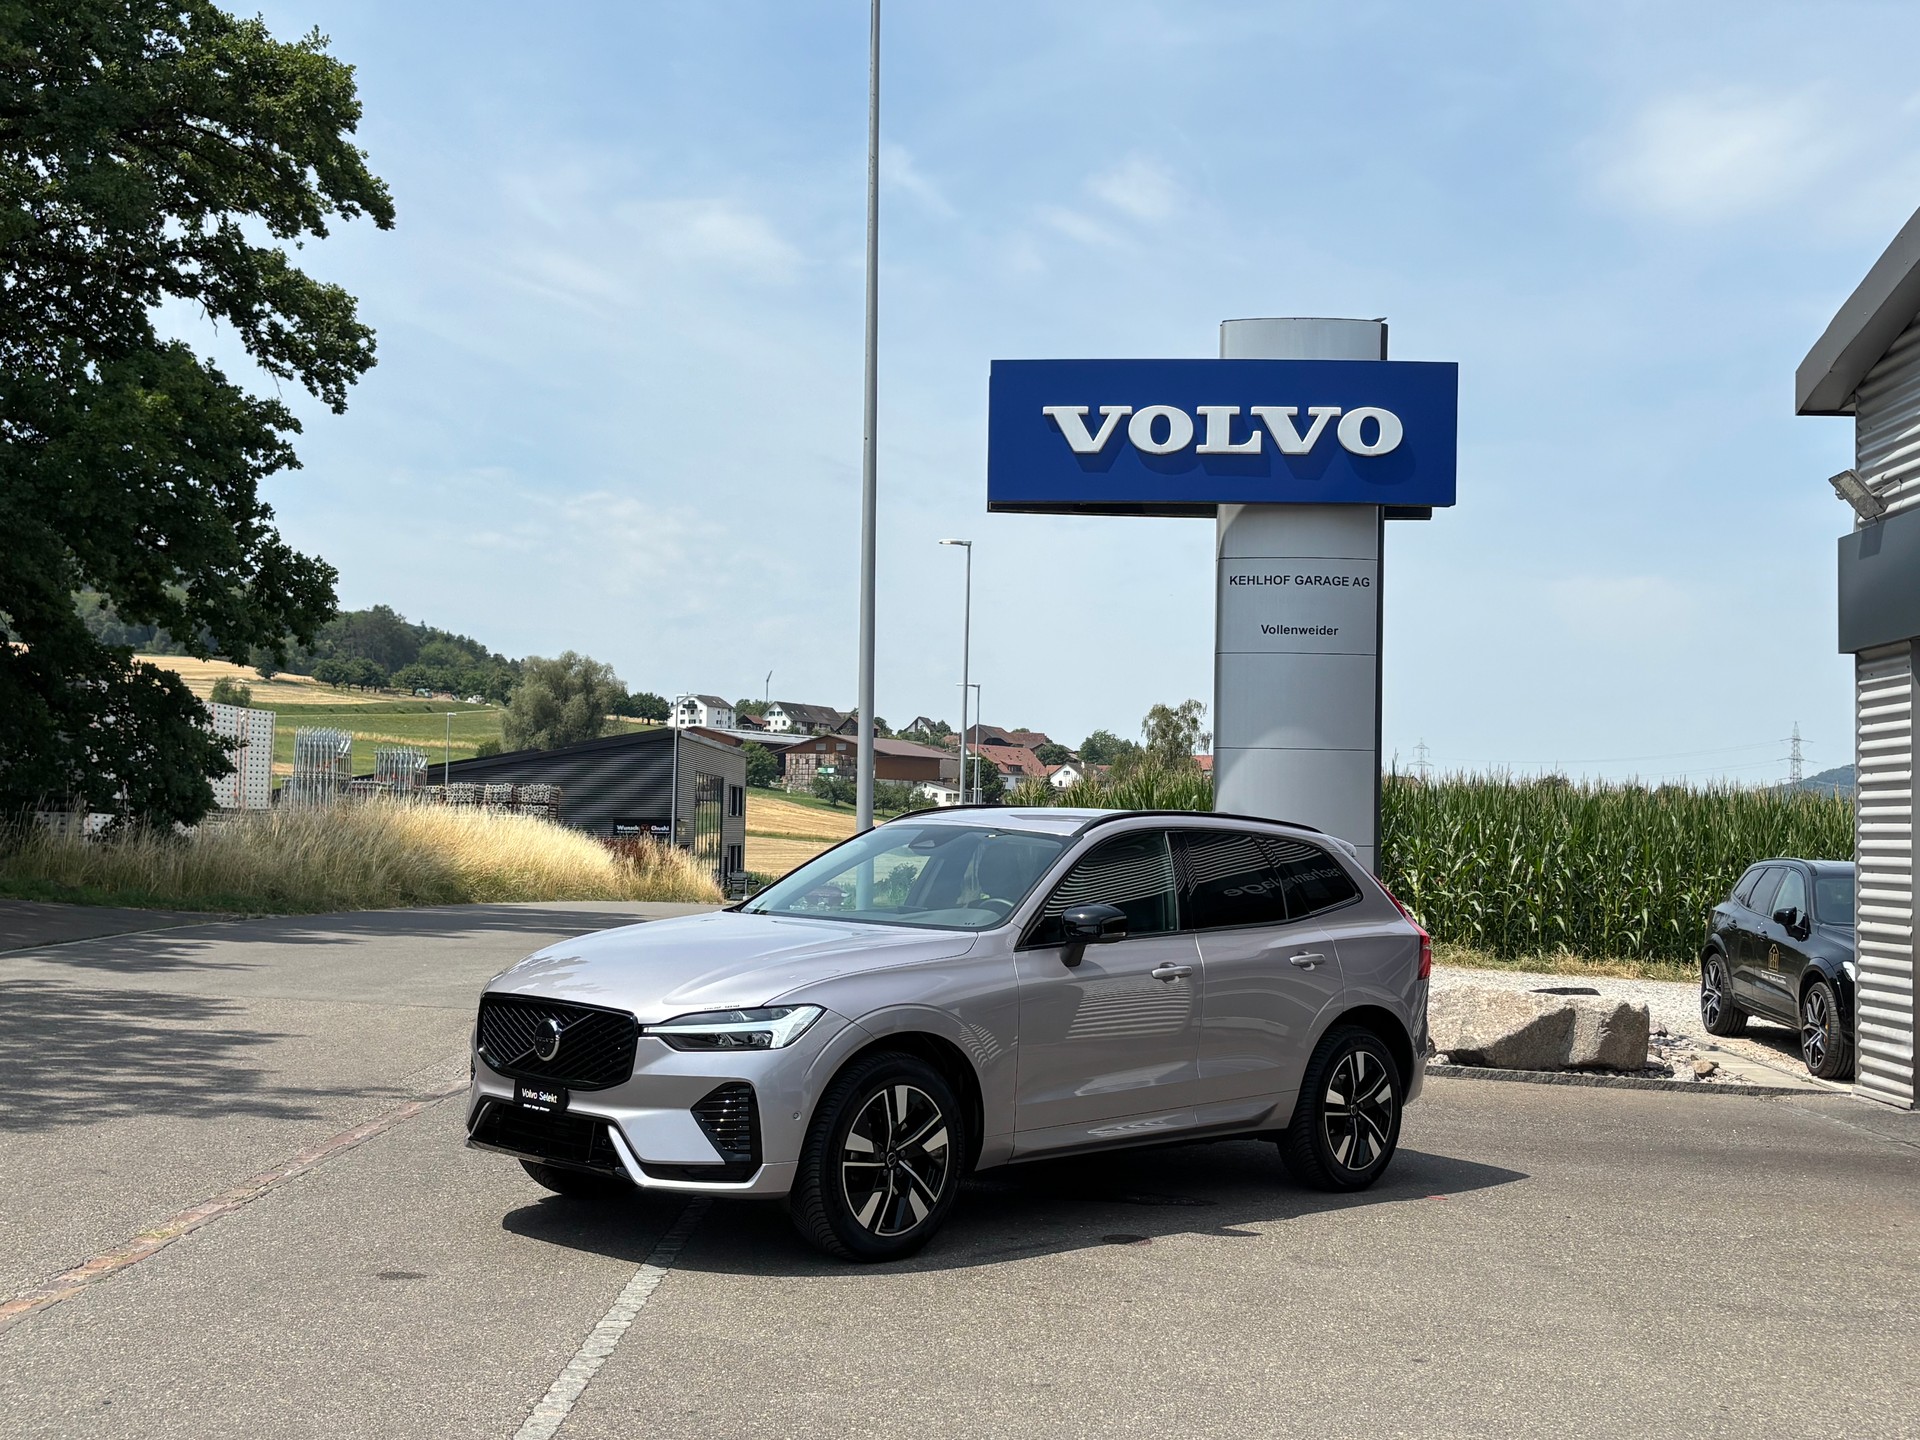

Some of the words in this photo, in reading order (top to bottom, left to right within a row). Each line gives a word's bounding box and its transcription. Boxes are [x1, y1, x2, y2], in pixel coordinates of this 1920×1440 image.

[1042, 405, 1403, 456] VOLVO
[1229, 575, 1291, 586] KEHLHOF
[1294, 575, 1350, 587] GARAGE
[1352, 577, 1371, 588] AG
[1261, 624, 1339, 636] Vollenweider
[521, 1087, 538, 1099] Volvo
[539, 1091, 558, 1104] Selekt
